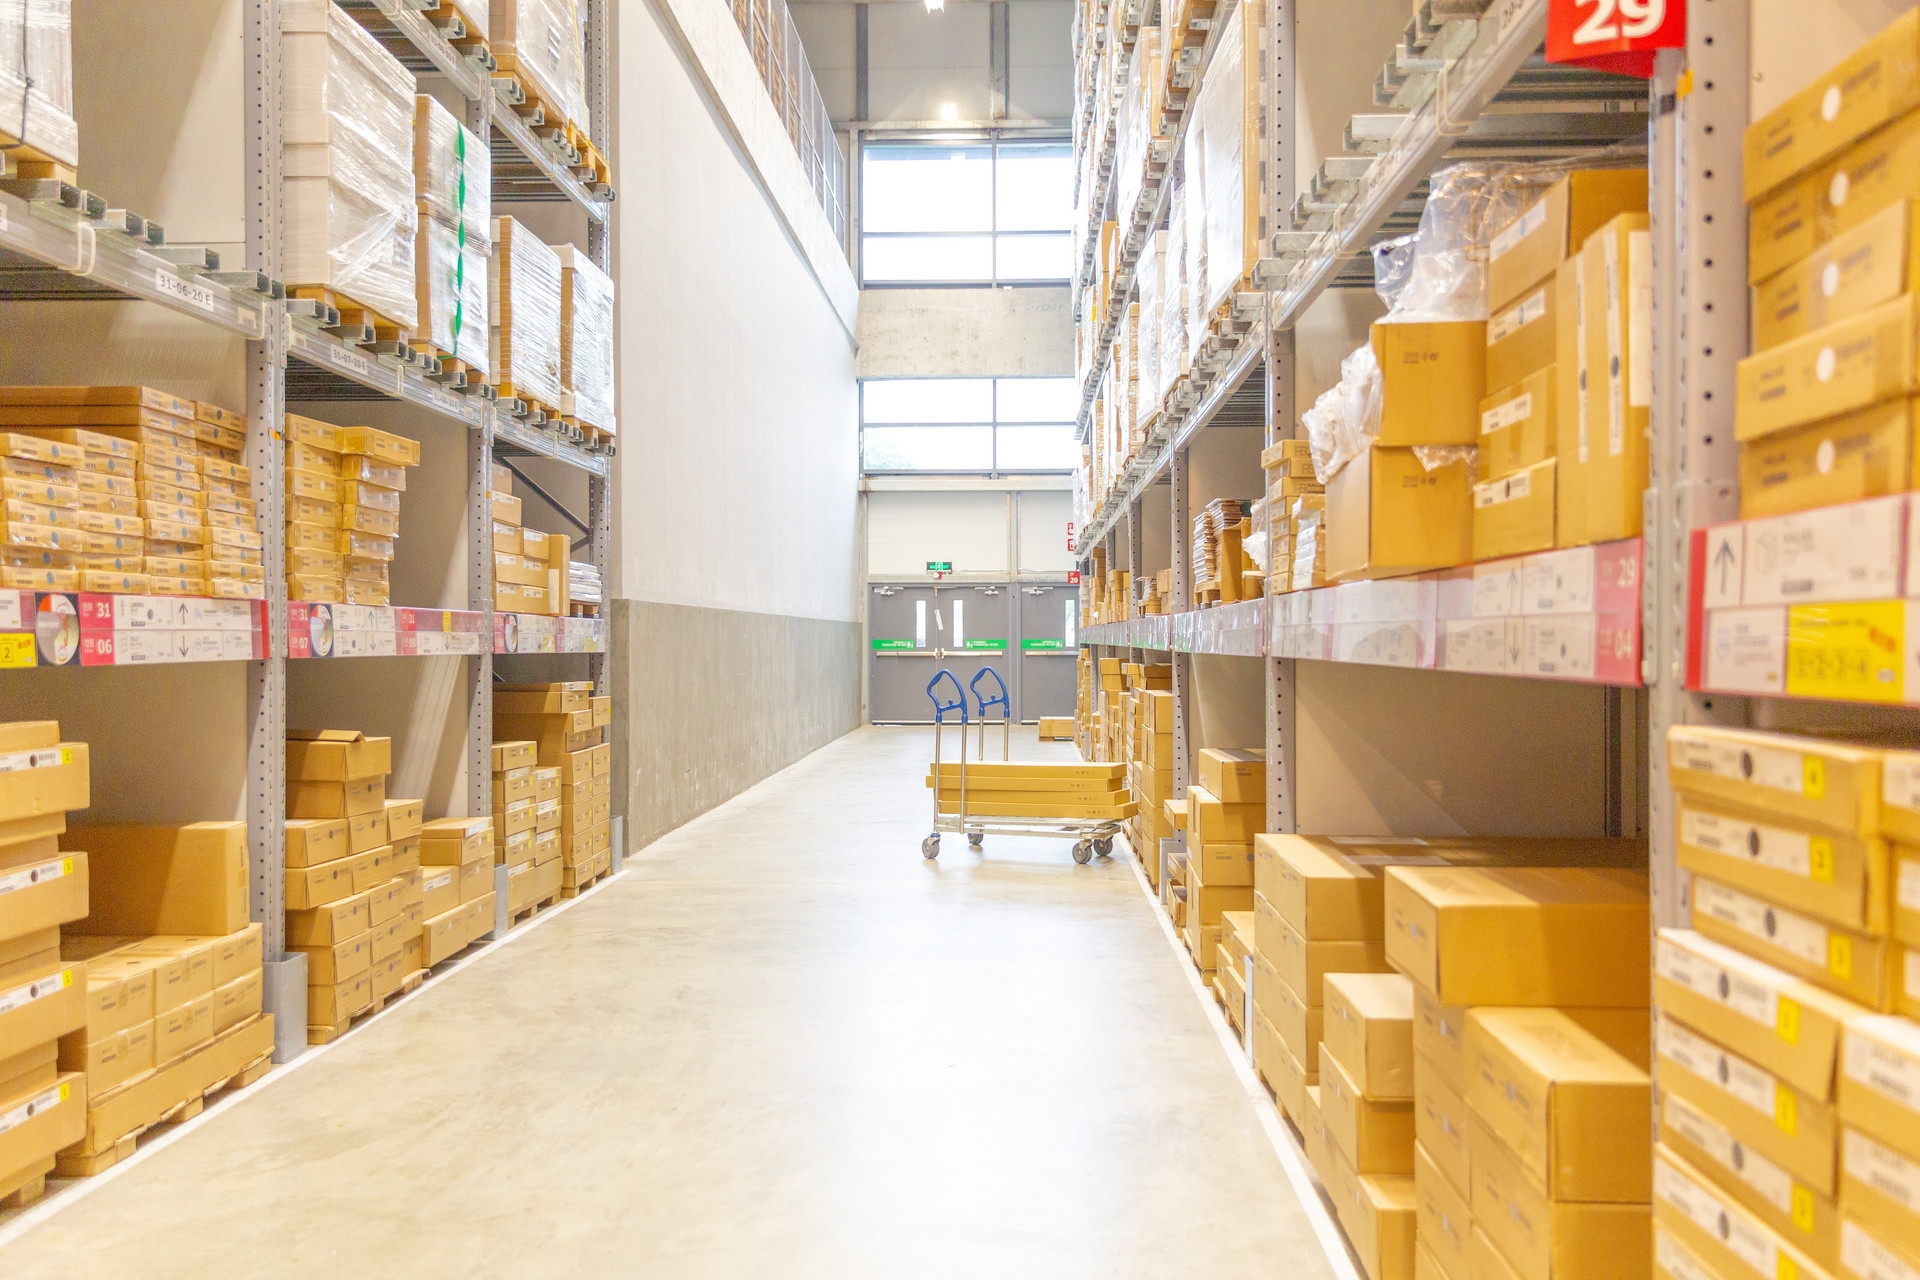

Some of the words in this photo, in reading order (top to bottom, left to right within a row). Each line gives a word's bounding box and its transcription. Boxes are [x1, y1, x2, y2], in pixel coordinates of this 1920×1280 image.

[1573, 0, 1667, 44] 29
[160, 275, 203, 302] 31-06-20
[205, 294, 211, 305] E
[1618, 557, 1636, 587] 29
[97, 602, 111, 618] 31
[299, 608, 309, 620] 31
[408, 613, 416, 624] 31
[97, 638, 113, 654] 06
[299, 637, 309, 649] 07
